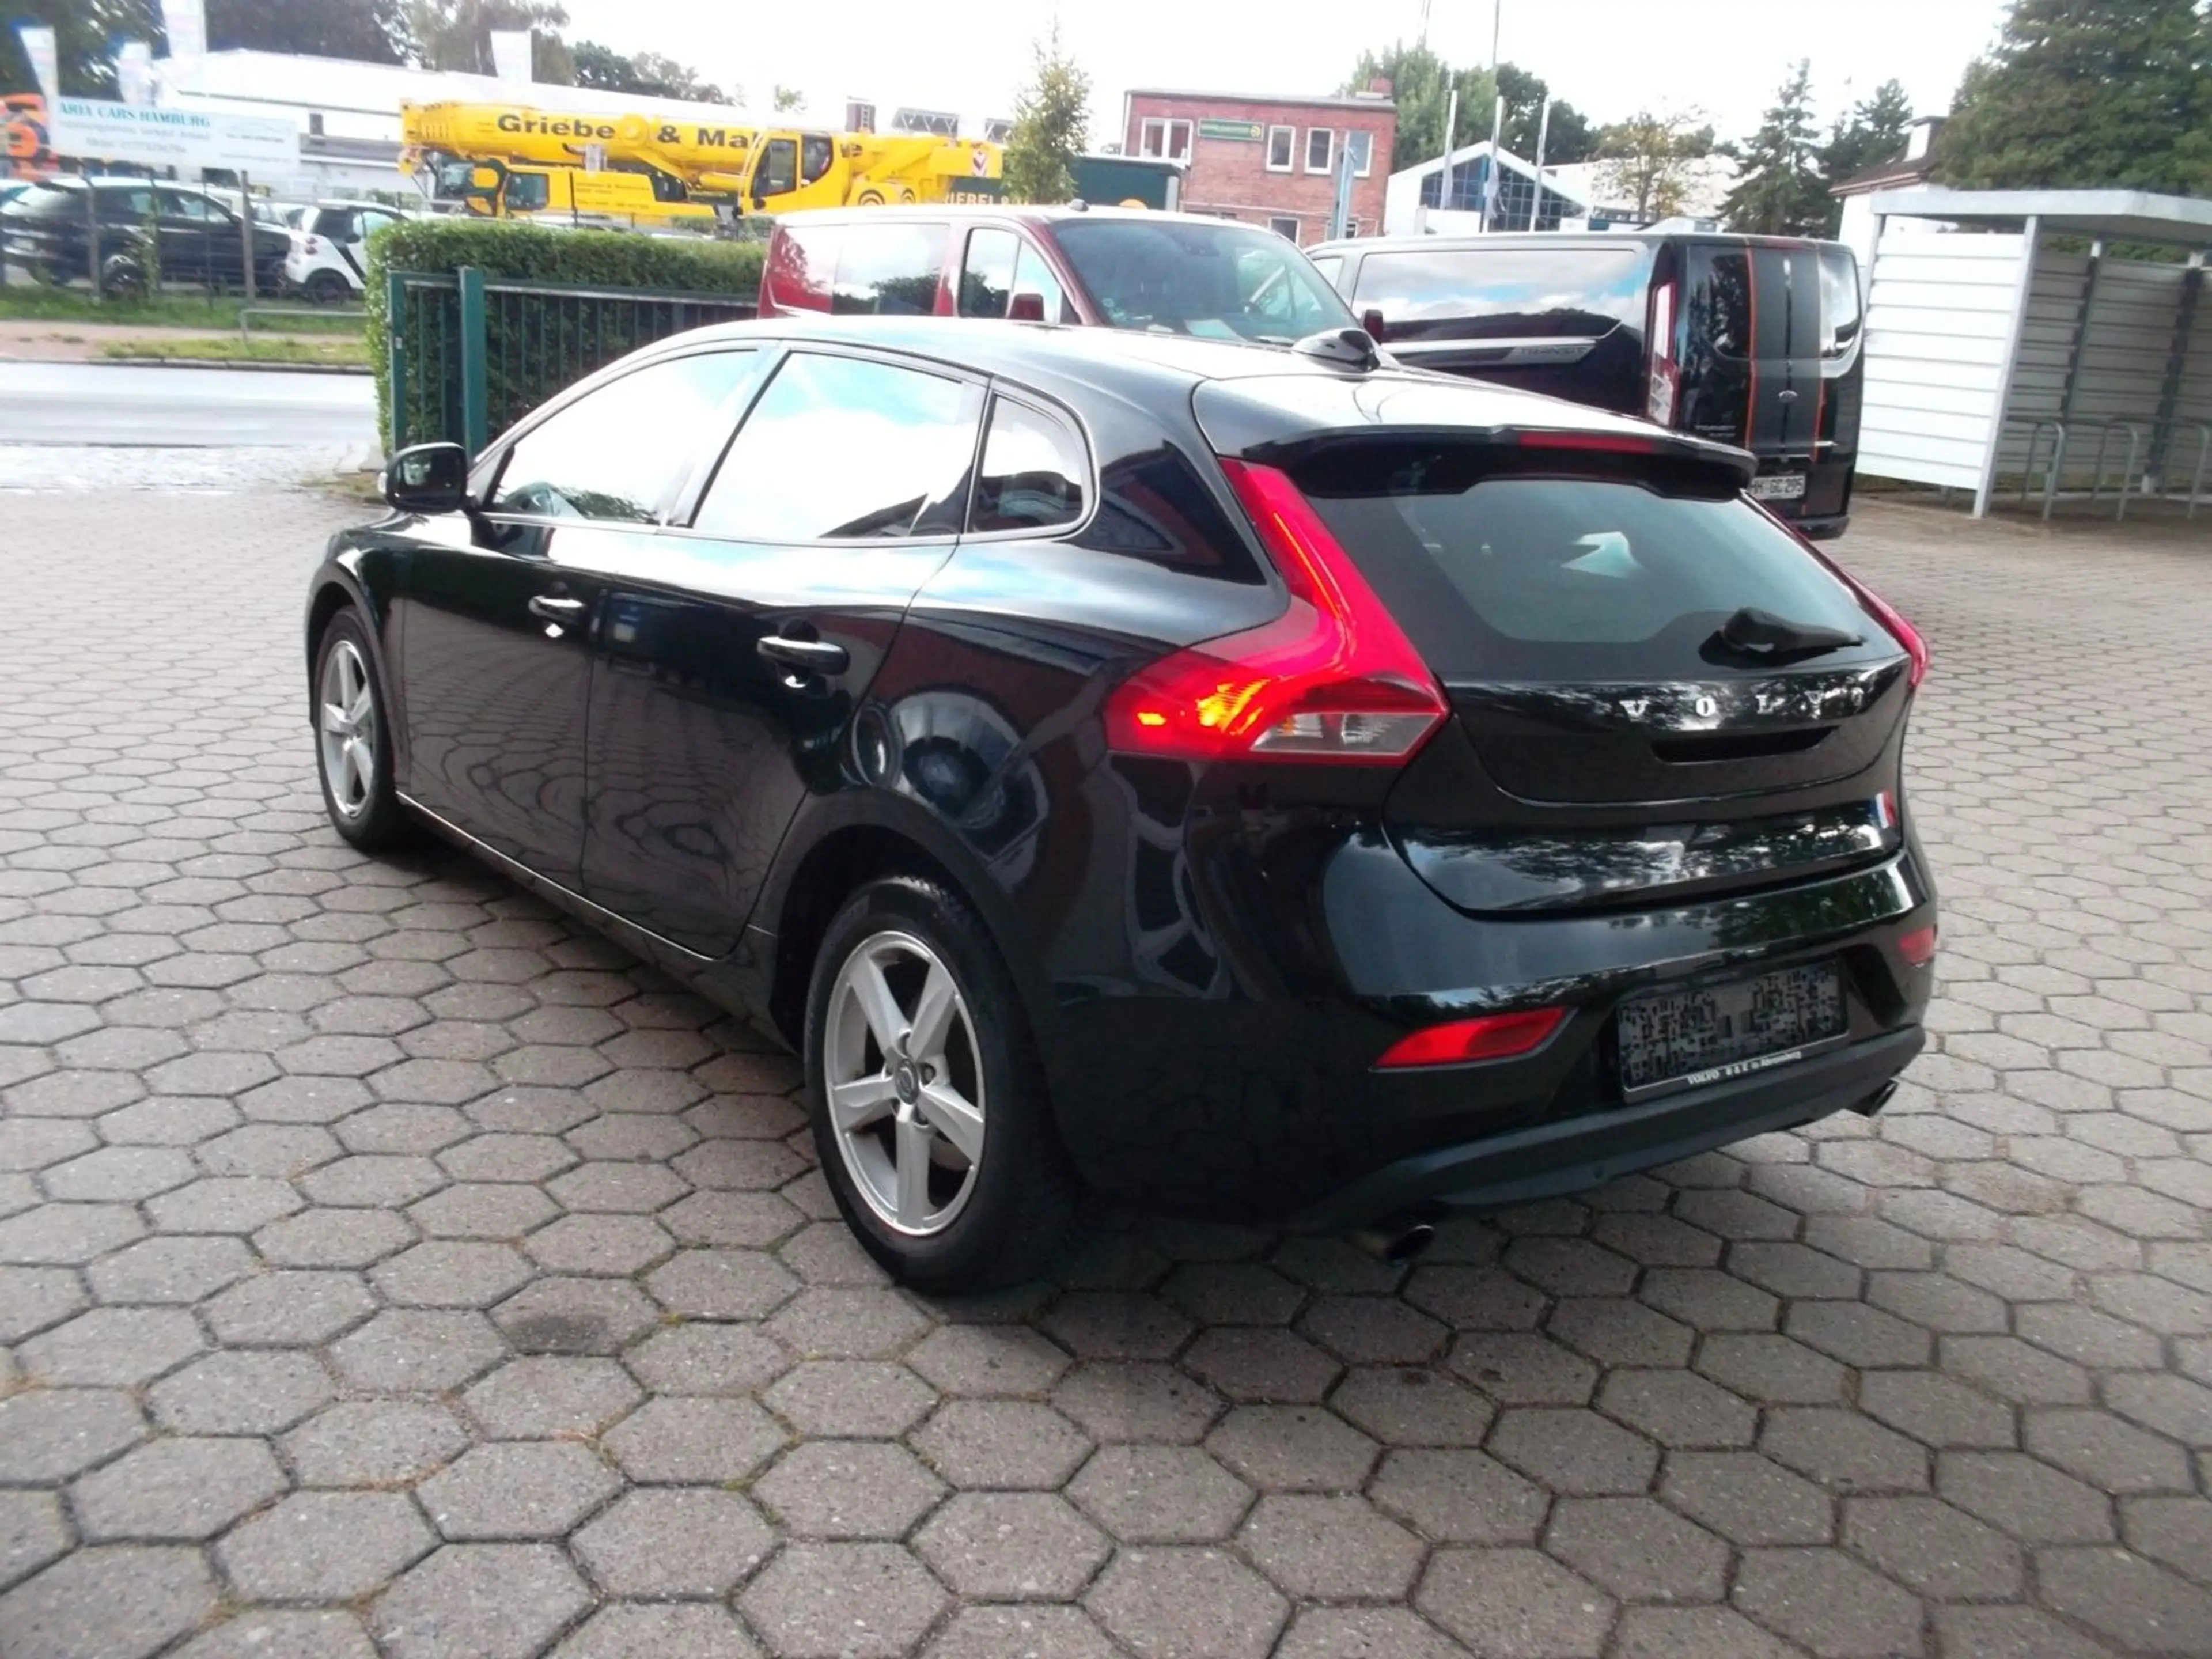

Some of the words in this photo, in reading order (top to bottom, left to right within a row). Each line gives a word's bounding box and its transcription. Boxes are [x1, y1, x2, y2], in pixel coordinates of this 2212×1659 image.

[97, 106, 136, 120] CARS
[139, 109, 210, 128] HAMBURG
[657, 124, 681, 144] &
[1619, 687, 1864, 722] VOLVO
